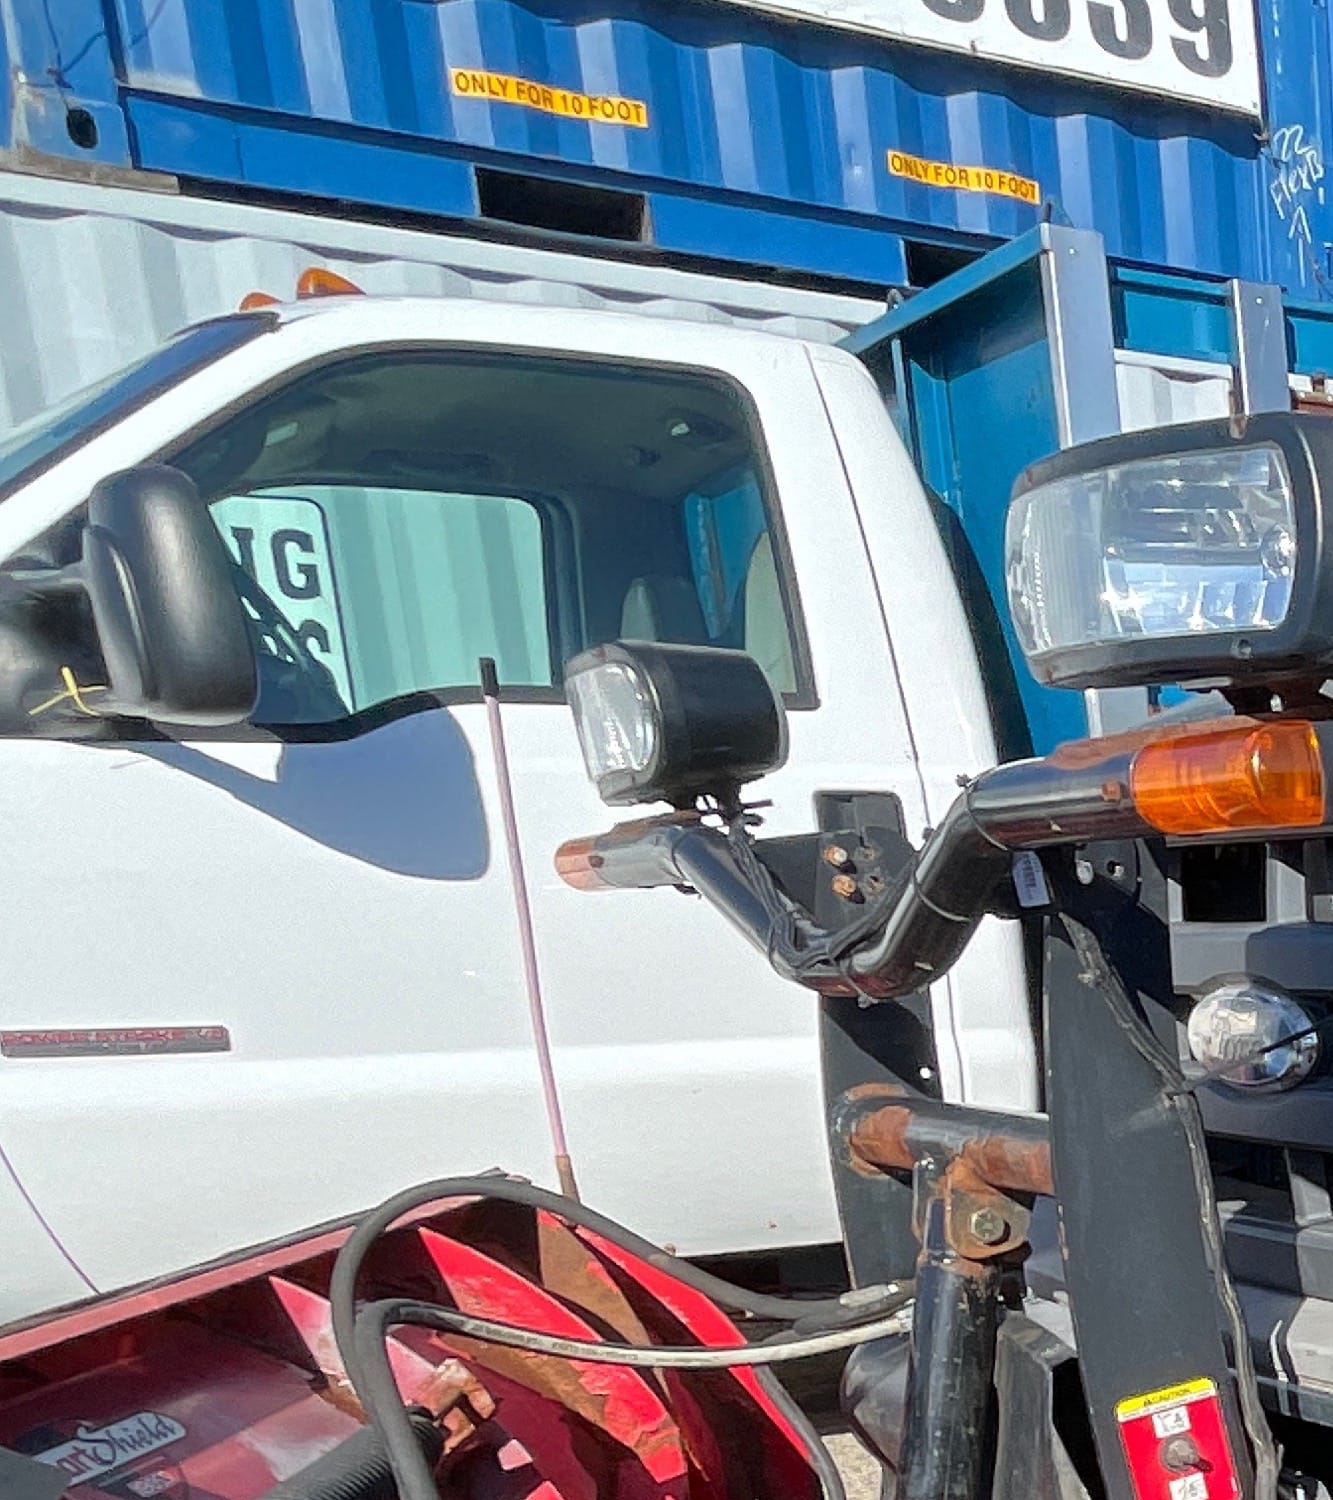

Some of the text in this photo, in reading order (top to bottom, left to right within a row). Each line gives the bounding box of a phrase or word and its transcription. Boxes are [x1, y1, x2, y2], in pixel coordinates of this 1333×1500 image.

[454, 71, 643, 123] ONLY FOR 10 FOOT
[891, 153, 1036, 201] ONLY FOR 10 FOOT
